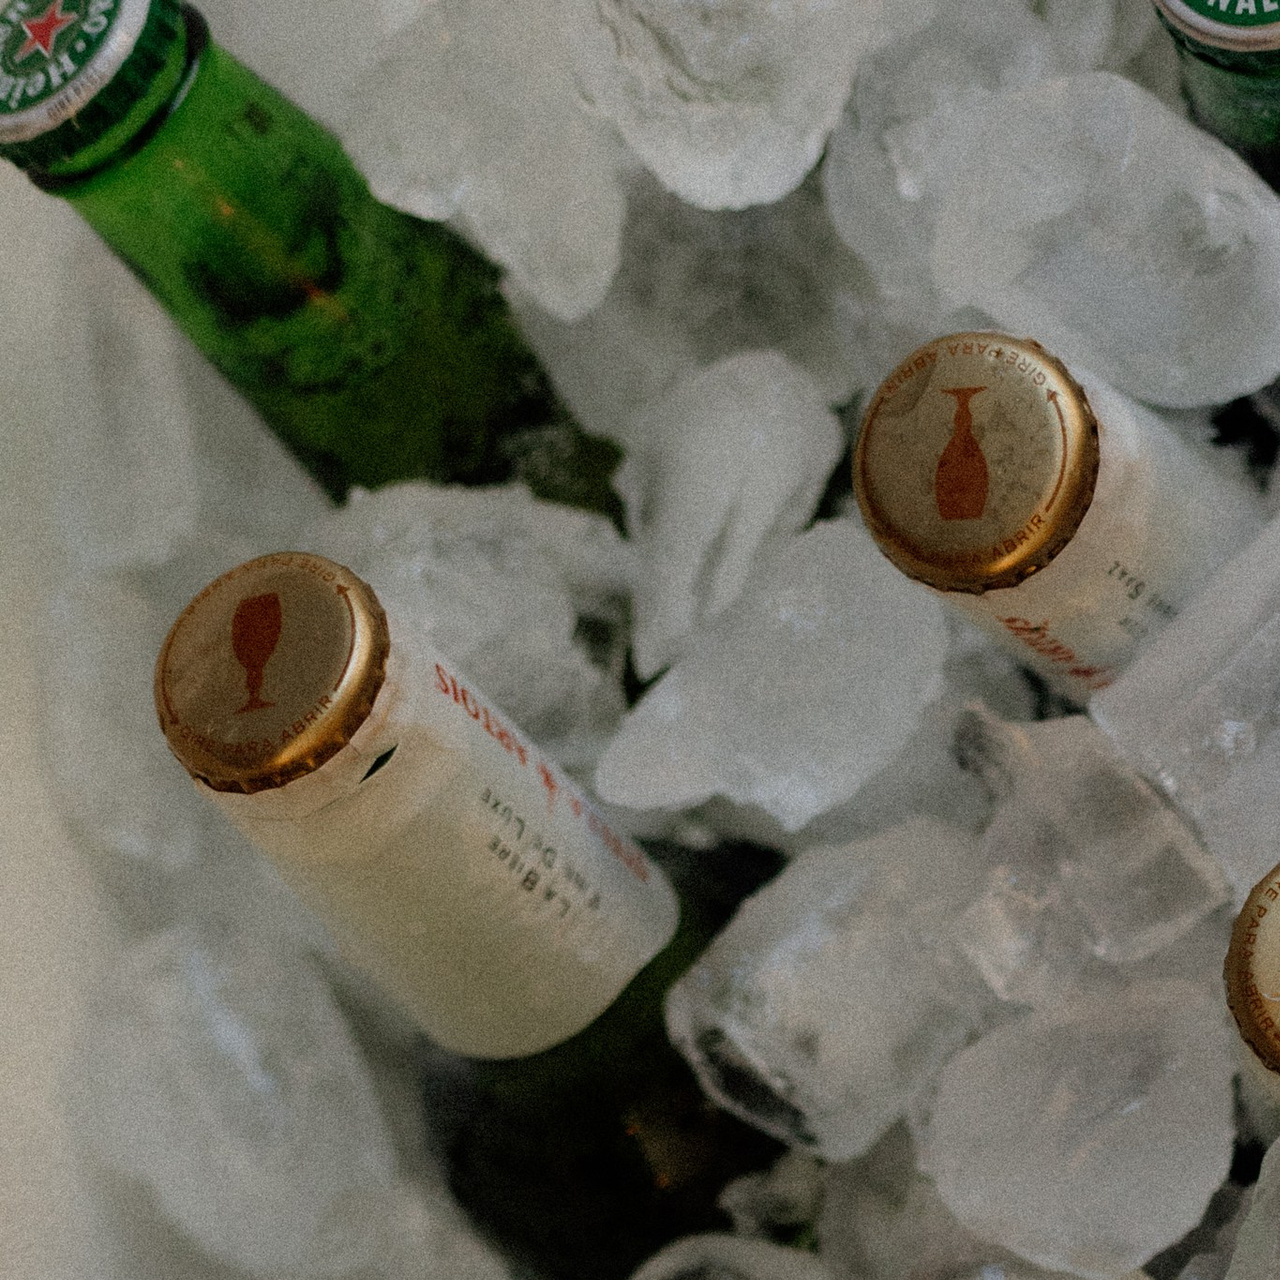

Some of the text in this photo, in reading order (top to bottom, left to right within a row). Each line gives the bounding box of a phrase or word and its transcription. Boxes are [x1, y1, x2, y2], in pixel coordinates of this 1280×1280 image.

[1003, 347, 1048, 388] GIRE
[990, 512, 1047, 558] ABRIR
[280, 694, 333, 744] ABRIR
